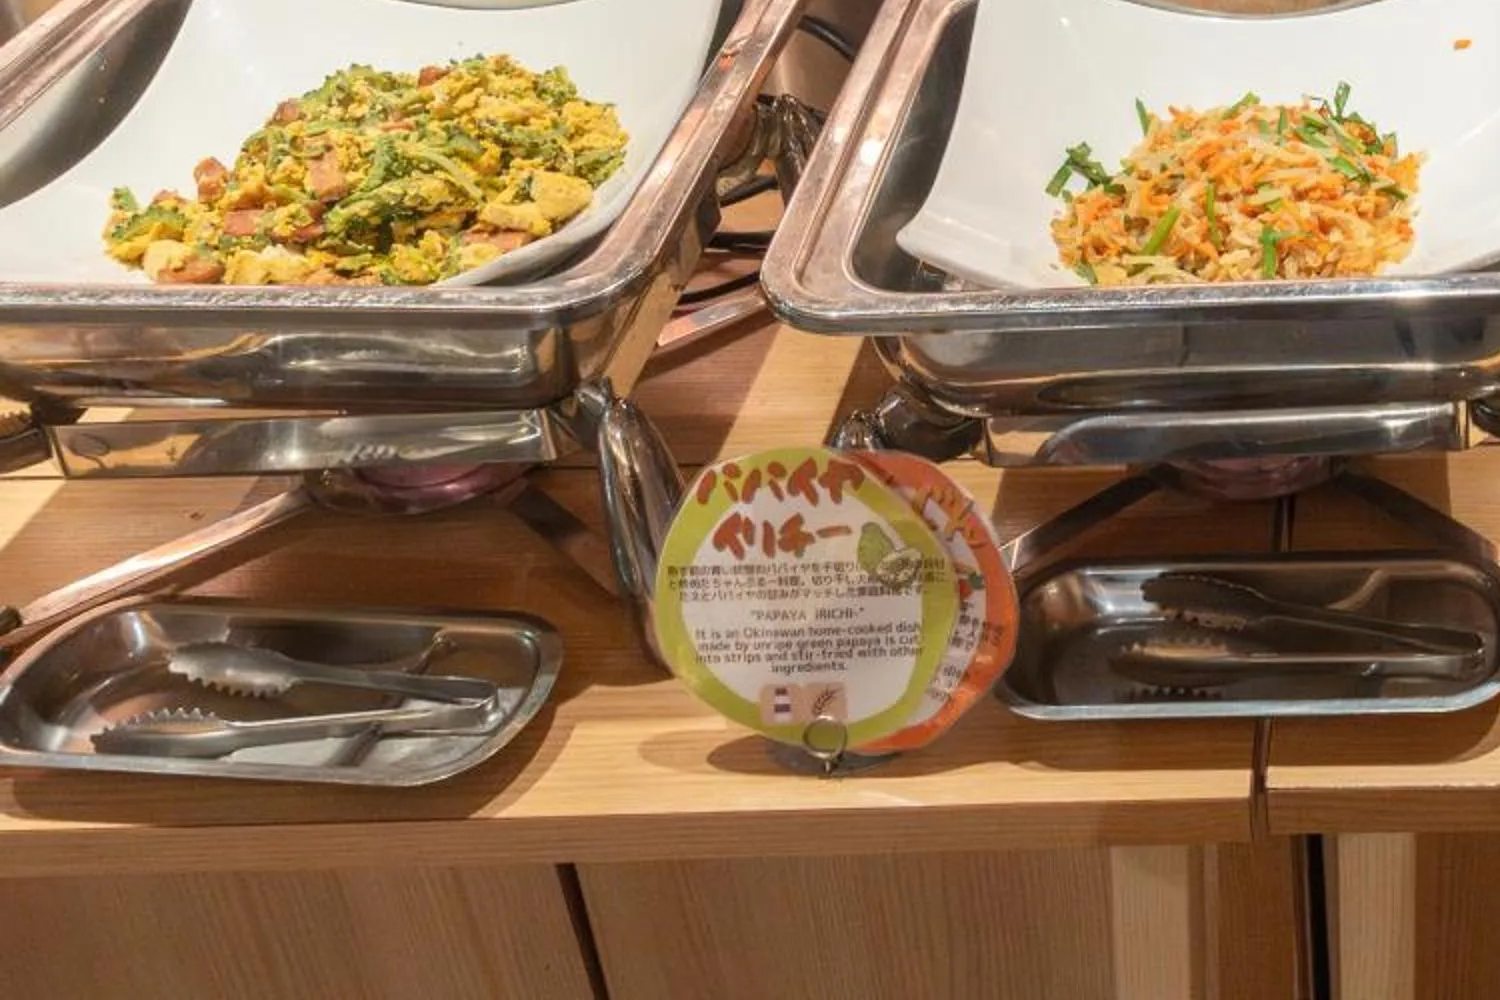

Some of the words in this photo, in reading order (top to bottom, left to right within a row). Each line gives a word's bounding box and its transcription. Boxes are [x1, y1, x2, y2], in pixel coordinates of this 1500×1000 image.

[696, 456, 866, 506] パパイヤ
[710, 627, 722, 638] is
[743, 626, 805, 639] Okinawan
[808, 622, 893, 637] home-cooked
[895, 620, 921, 634] dish
[697, 638, 727, 650] made
[734, 638, 749, 652] by
[796, 638, 833, 651] green
[836, 636, 881, 650] papaya
[886, 635, 896, 646] is
[723, 650, 762, 666] strips
[765, 650, 788, 662] and
[791, 647, 853, 661] stir-fried
[857, 645, 887, 658] with
